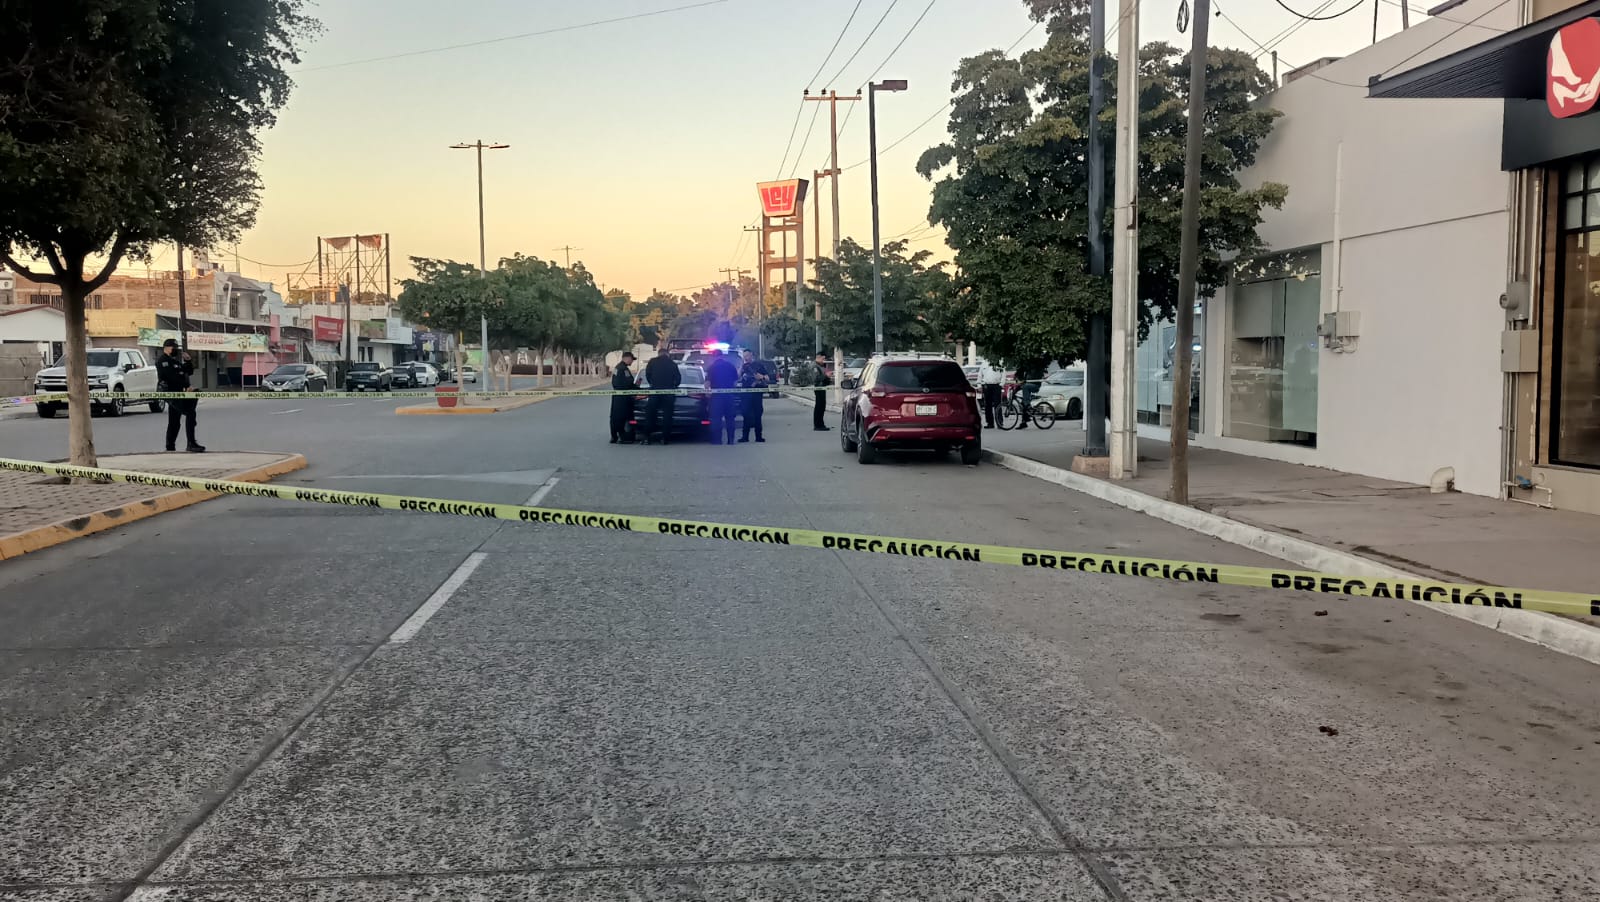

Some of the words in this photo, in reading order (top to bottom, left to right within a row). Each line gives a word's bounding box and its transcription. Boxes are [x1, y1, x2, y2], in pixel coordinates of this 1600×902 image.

[658, 521, 791, 545] PRECAUCIÓN
[822, 535, 981, 562] PRECAUCIÓN
[1021, 552, 1219, 584] PRECAUCIÓN
[1271, 573, 1523, 610] PRECAUCIÓN
